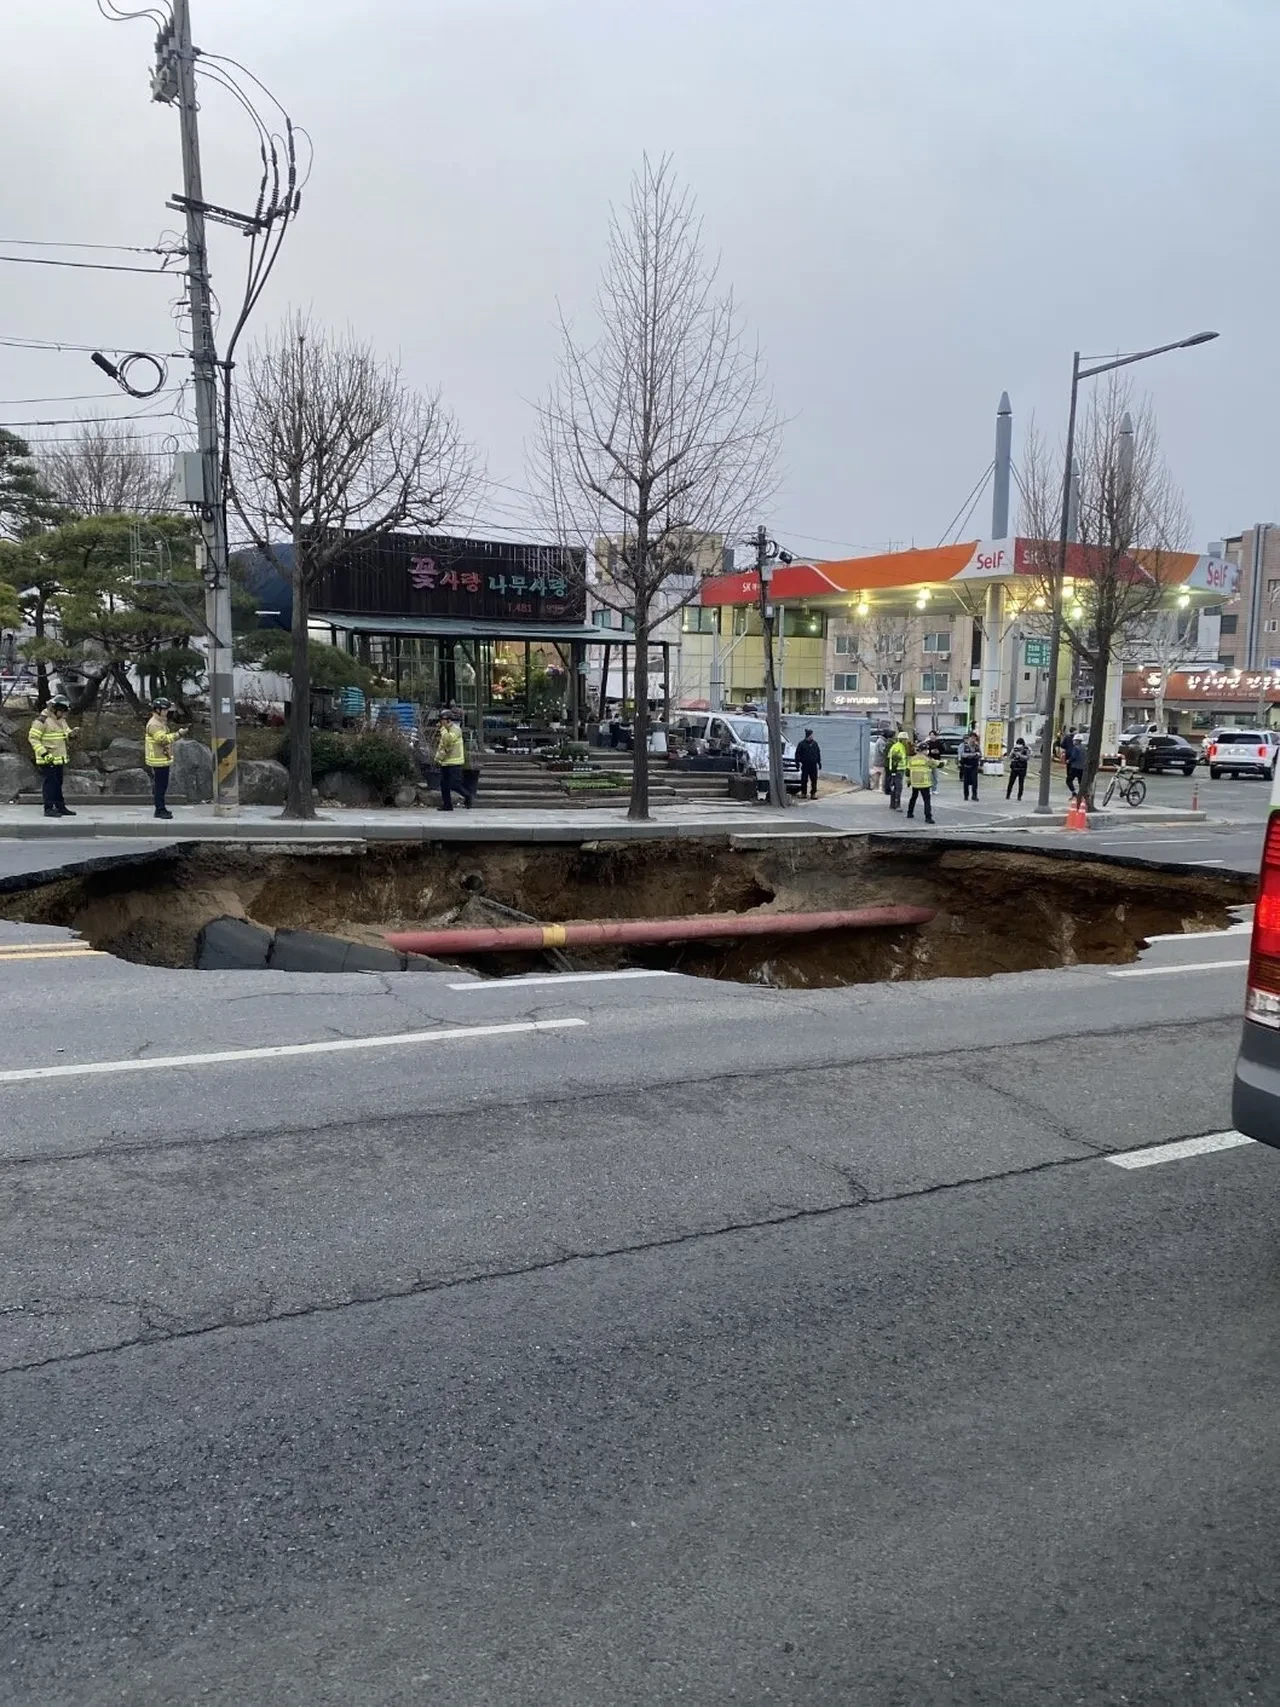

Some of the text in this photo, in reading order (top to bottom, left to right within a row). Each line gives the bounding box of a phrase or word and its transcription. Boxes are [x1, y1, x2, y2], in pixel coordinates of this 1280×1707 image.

[976, 551, 1005, 570] Self
[488, 574, 568, 597] 나무사랑
[1206, 561, 1229, 587] Self
